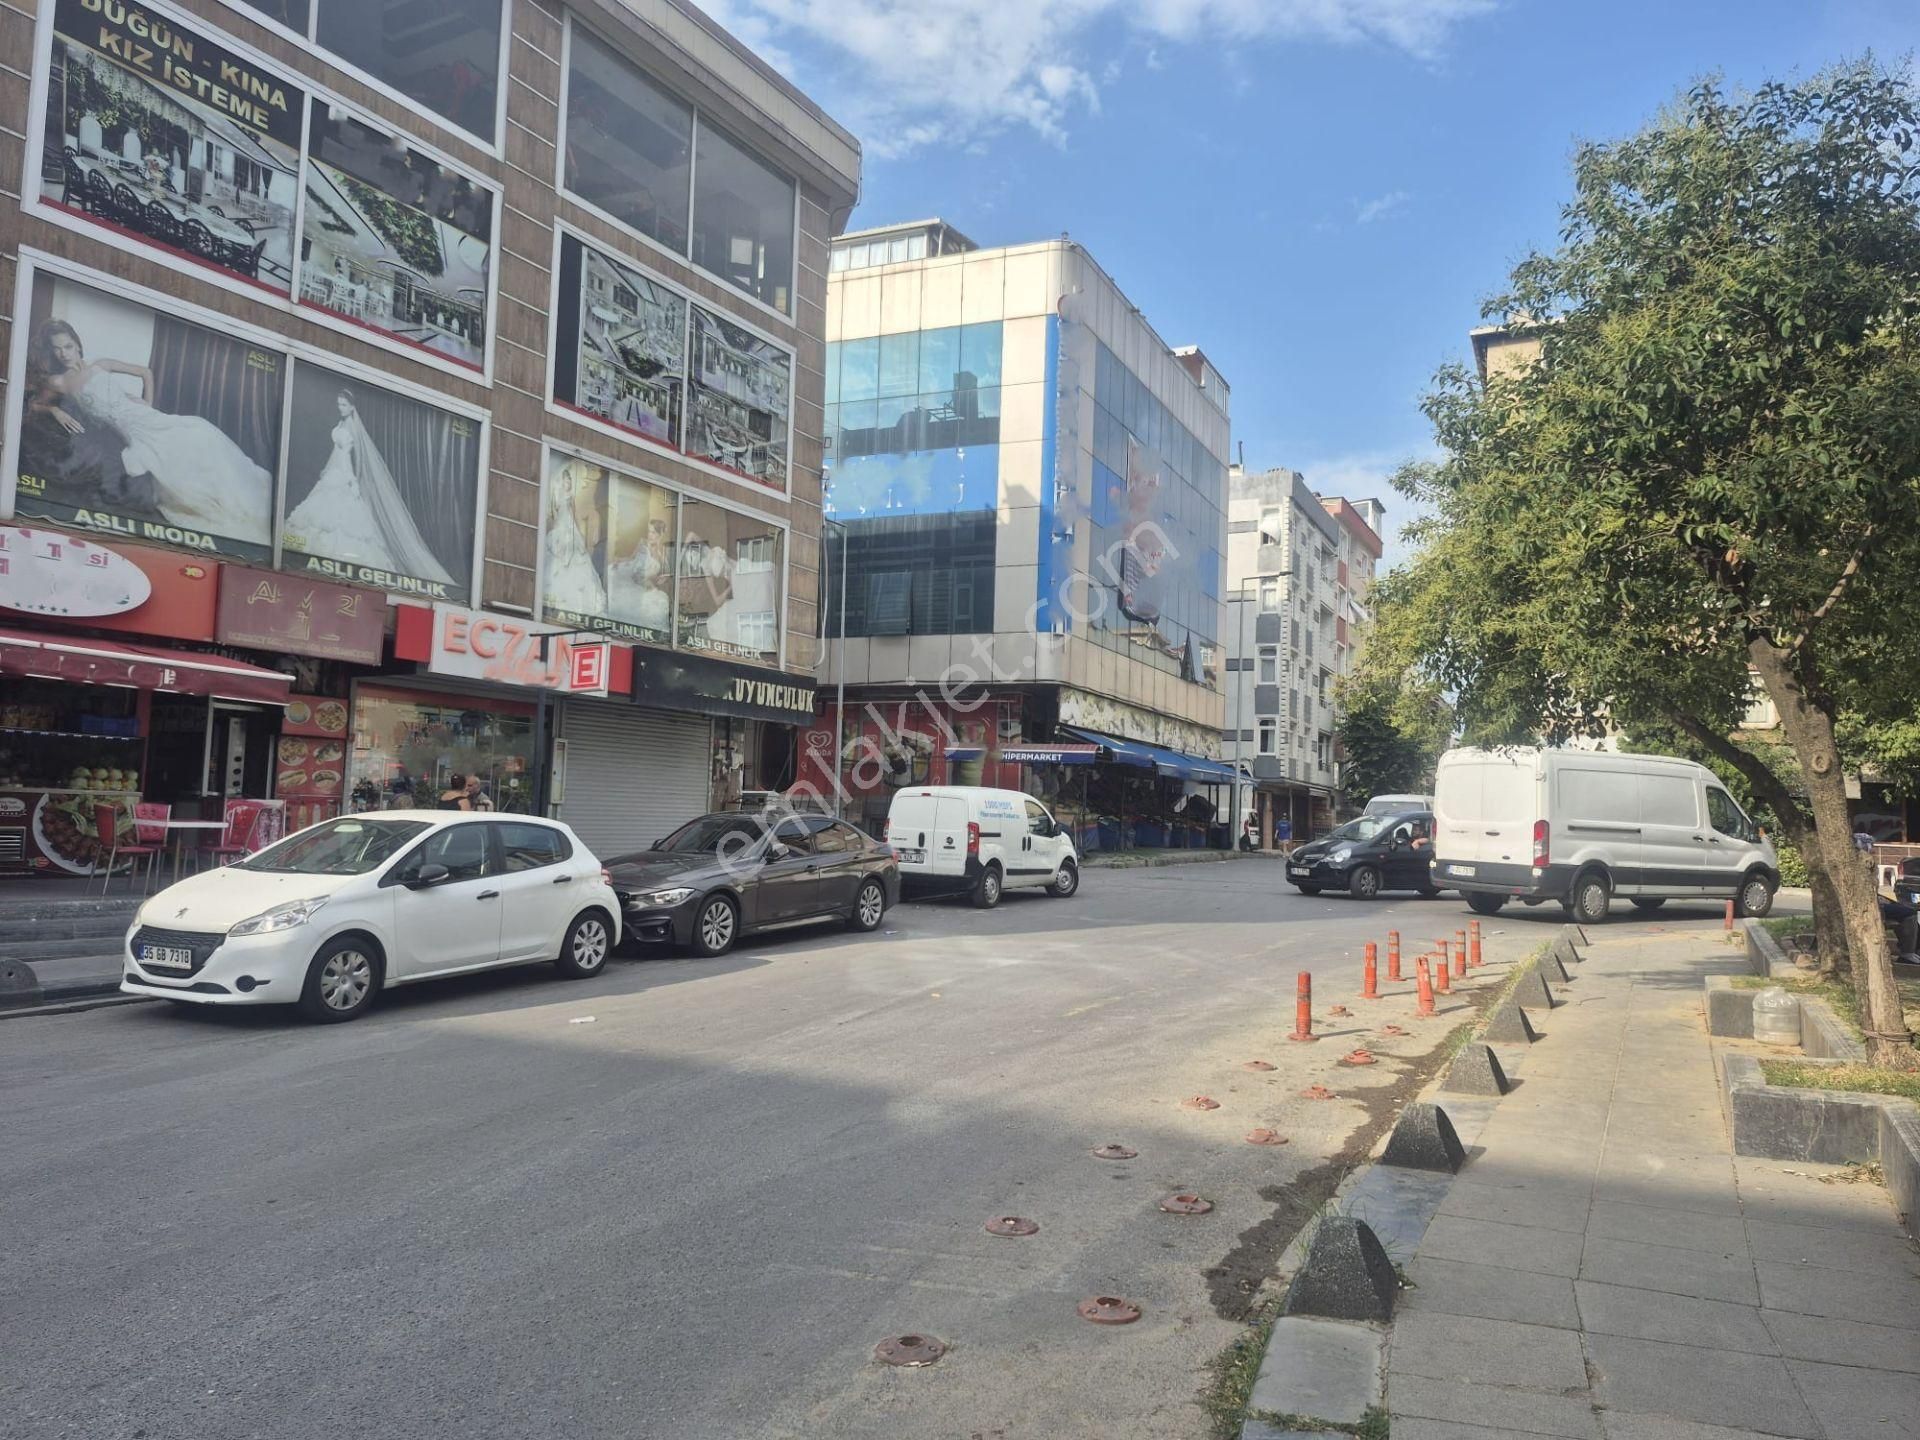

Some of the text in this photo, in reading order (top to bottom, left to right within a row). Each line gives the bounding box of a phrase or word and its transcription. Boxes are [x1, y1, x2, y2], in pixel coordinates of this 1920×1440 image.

[100, 26, 270, 130] KIZ İSTEME
[220, 60, 288, 113] KINA
[73, 508, 218, 552] ASLI MODA
[306, 556, 353, 579] ASLI
[557, 610, 590, 628] ASLI
[687, 635, 711, 650] ASLI
[577, 651, 598, 685] E
[144, 946, 153, 959] 35
